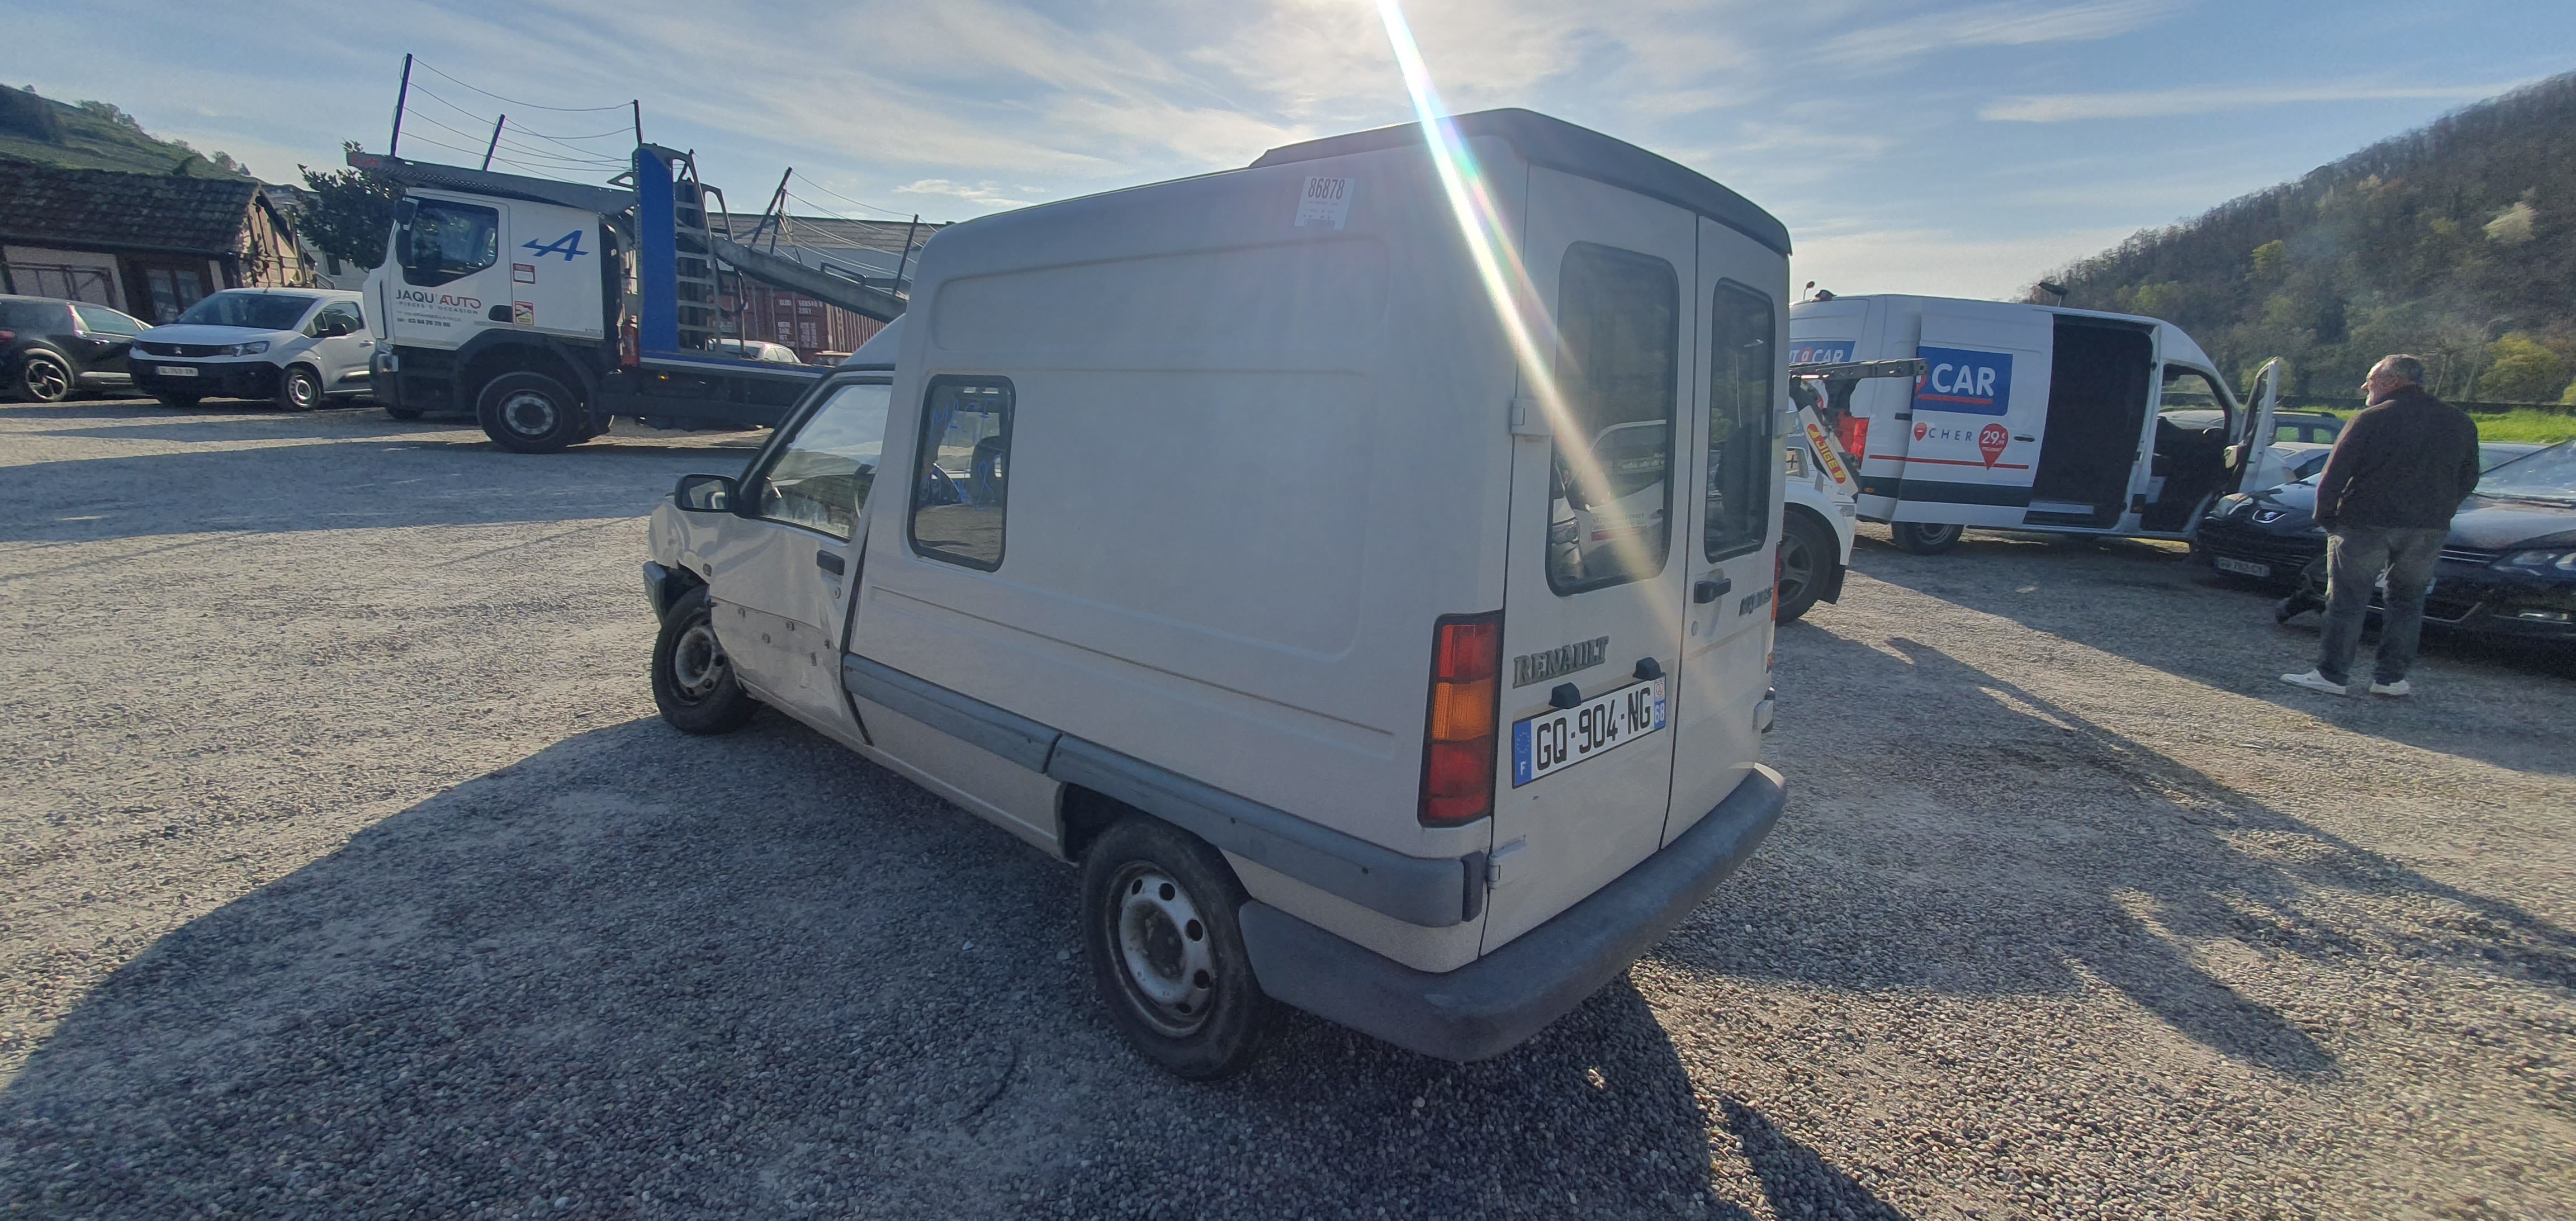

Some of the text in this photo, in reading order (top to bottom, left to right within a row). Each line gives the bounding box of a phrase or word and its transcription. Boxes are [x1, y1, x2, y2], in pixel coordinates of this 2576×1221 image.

[1308, 177, 1345, 200] 86878
[1931, 363, 1996, 396] CAR
[1512, 635, 1610, 689] RENAULT
[1519, 760, 1527, 776] F
[1654, 702, 1665, 723] 68
